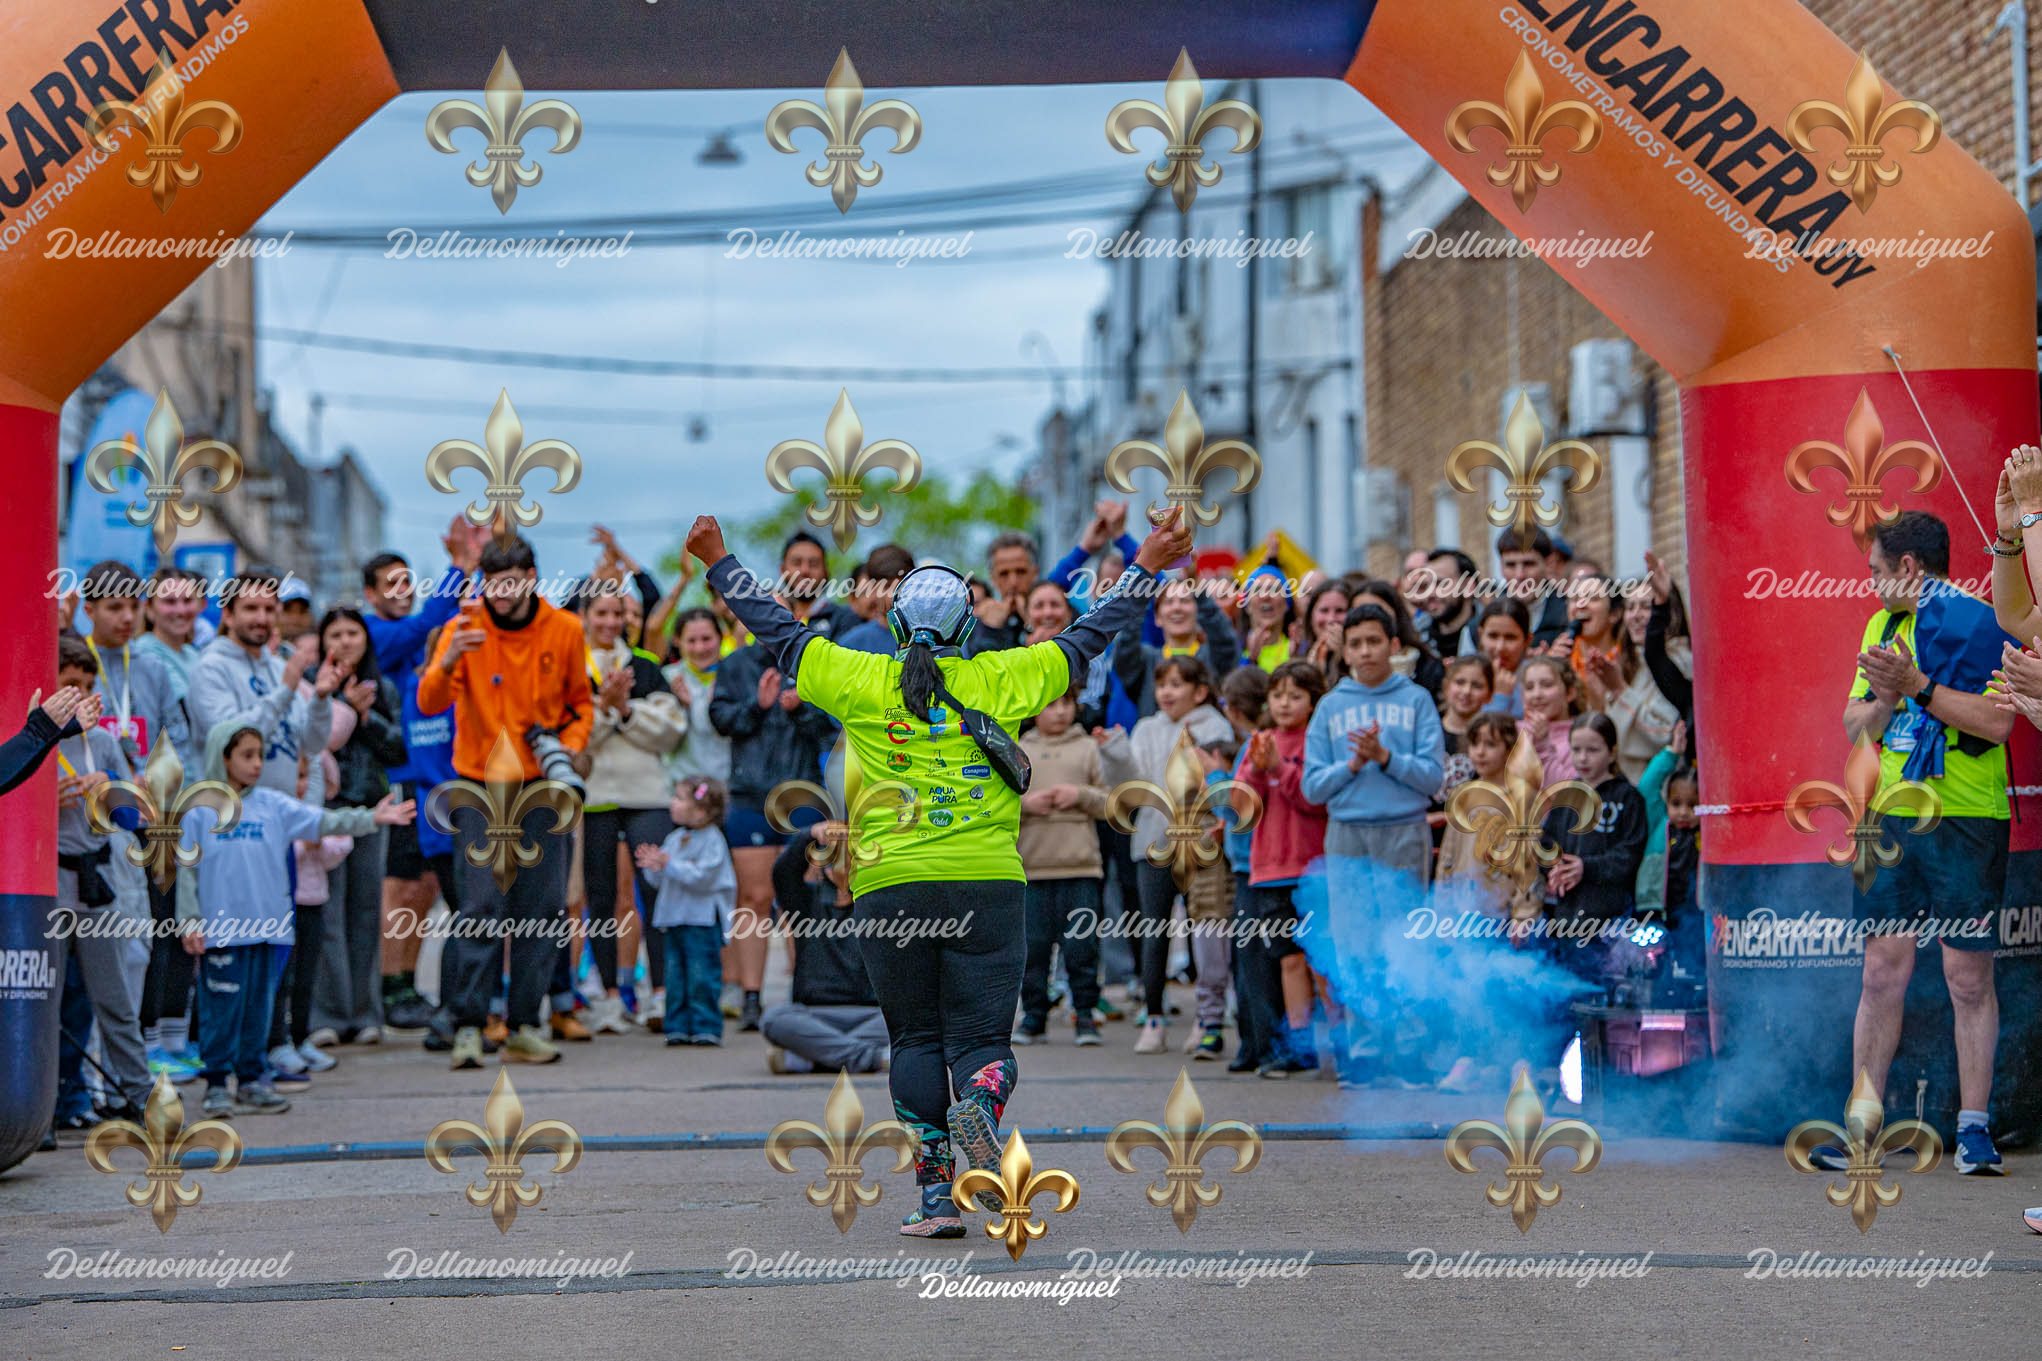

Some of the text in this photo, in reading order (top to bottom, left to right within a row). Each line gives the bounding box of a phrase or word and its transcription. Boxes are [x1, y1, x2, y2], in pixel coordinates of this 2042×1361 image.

[117, 118, 133, 139] Y
[134, 14, 250, 127] DIFUNDIMOS
[1499, 6, 1795, 273] CRONOMETRAMOS Y DIFUNDIMOS
[928, 786, 956, 796] AQUA
[931, 795, 958, 804] PURA
